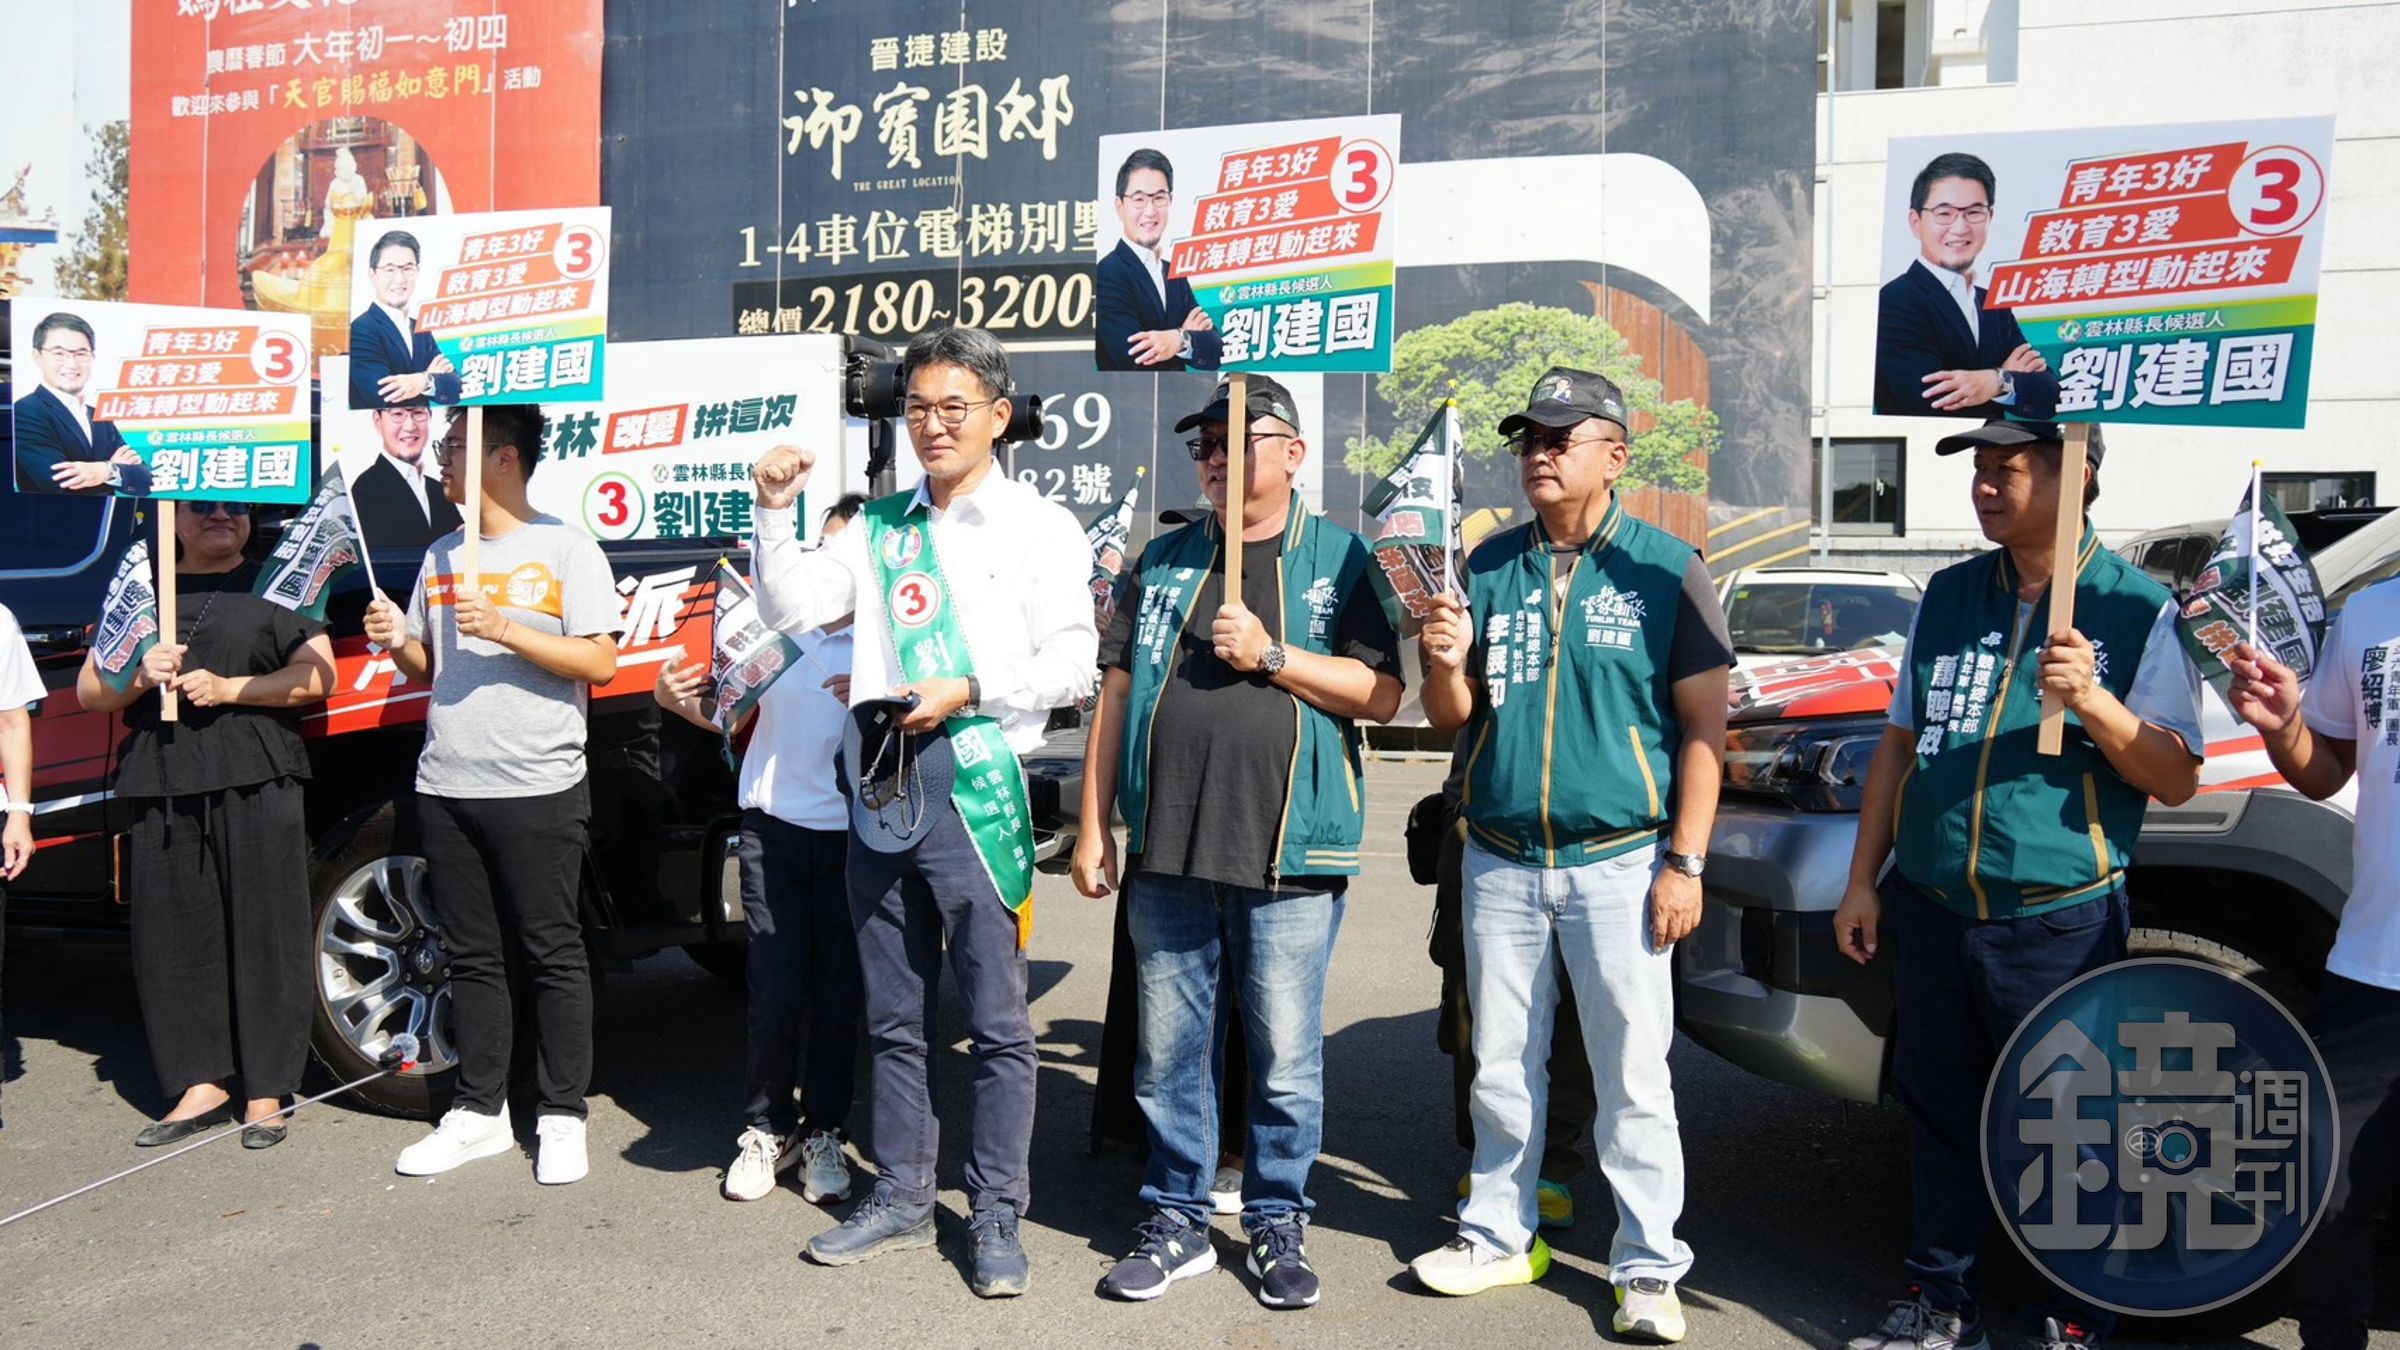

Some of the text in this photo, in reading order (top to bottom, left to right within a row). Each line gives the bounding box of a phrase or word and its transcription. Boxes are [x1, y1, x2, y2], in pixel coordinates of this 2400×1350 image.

[207, 44, 287, 74] 農曆春節
[870, 28, 1008, 71] 晉捷建設
[783, 74, 1073, 181] 御寶園邸
[853, 181, 871, 192] THE
[876, 179, 907, 191] GREAT
[1223, 146, 1320, 189] 青年3好
[1345, 149, 1378, 204] 3
[2068, 152, 2214, 205] 青年3好
[1203, 189, 1299, 231] 教育3愛
[2249, 158, 2301, 226] 3
[463, 229, 545, 261] 青年3好
[1175, 222, 1361, 275] 山海轉型動起來
[2037, 205, 2180, 256] 教育3愛
[565, 232, 592, 274] 3
[446, 262, 529, 295] 教育3愛
[1237, 275, 1333, 300] 雲林縣長候選人
[1995, 246, 2271, 306] 山海轉型動起來
[422, 286, 580, 330] 山海轉型動起來
[738, 271, 1096, 335] 總價2180~3200
[2085, 308, 2226, 338] 雲林縣長候選人
[147, 331, 240, 355] 青年3好
[474, 328, 557, 350] 雲林縣長候選人
[1220, 292, 1380, 365] 劉建國
[128, 361, 223, 386] 教育3愛
[264, 338, 294, 379] 3
[459, 339, 595, 400] 劉建國
[2054, 333, 2294, 413] 劉建國
[100, 391, 280, 418] 山海轉型動起來
[1012, 391, 1112, 450] 69
[164, 429, 257, 444] 雲林縣長候選人
[536, 394, 798, 462] 林 改變 拼這次
[150, 444, 299, 493] 劉建國
[597, 481, 629, 527] 3
[899, 582, 927, 616] 3
[1526, 612, 1542, 682] 競選總本部
[1956, 651, 1976, 688] 青年軍
[2361, 645, 2389, 731] 廖紹博
[1960, 653, 1996, 734] 競選總本部
